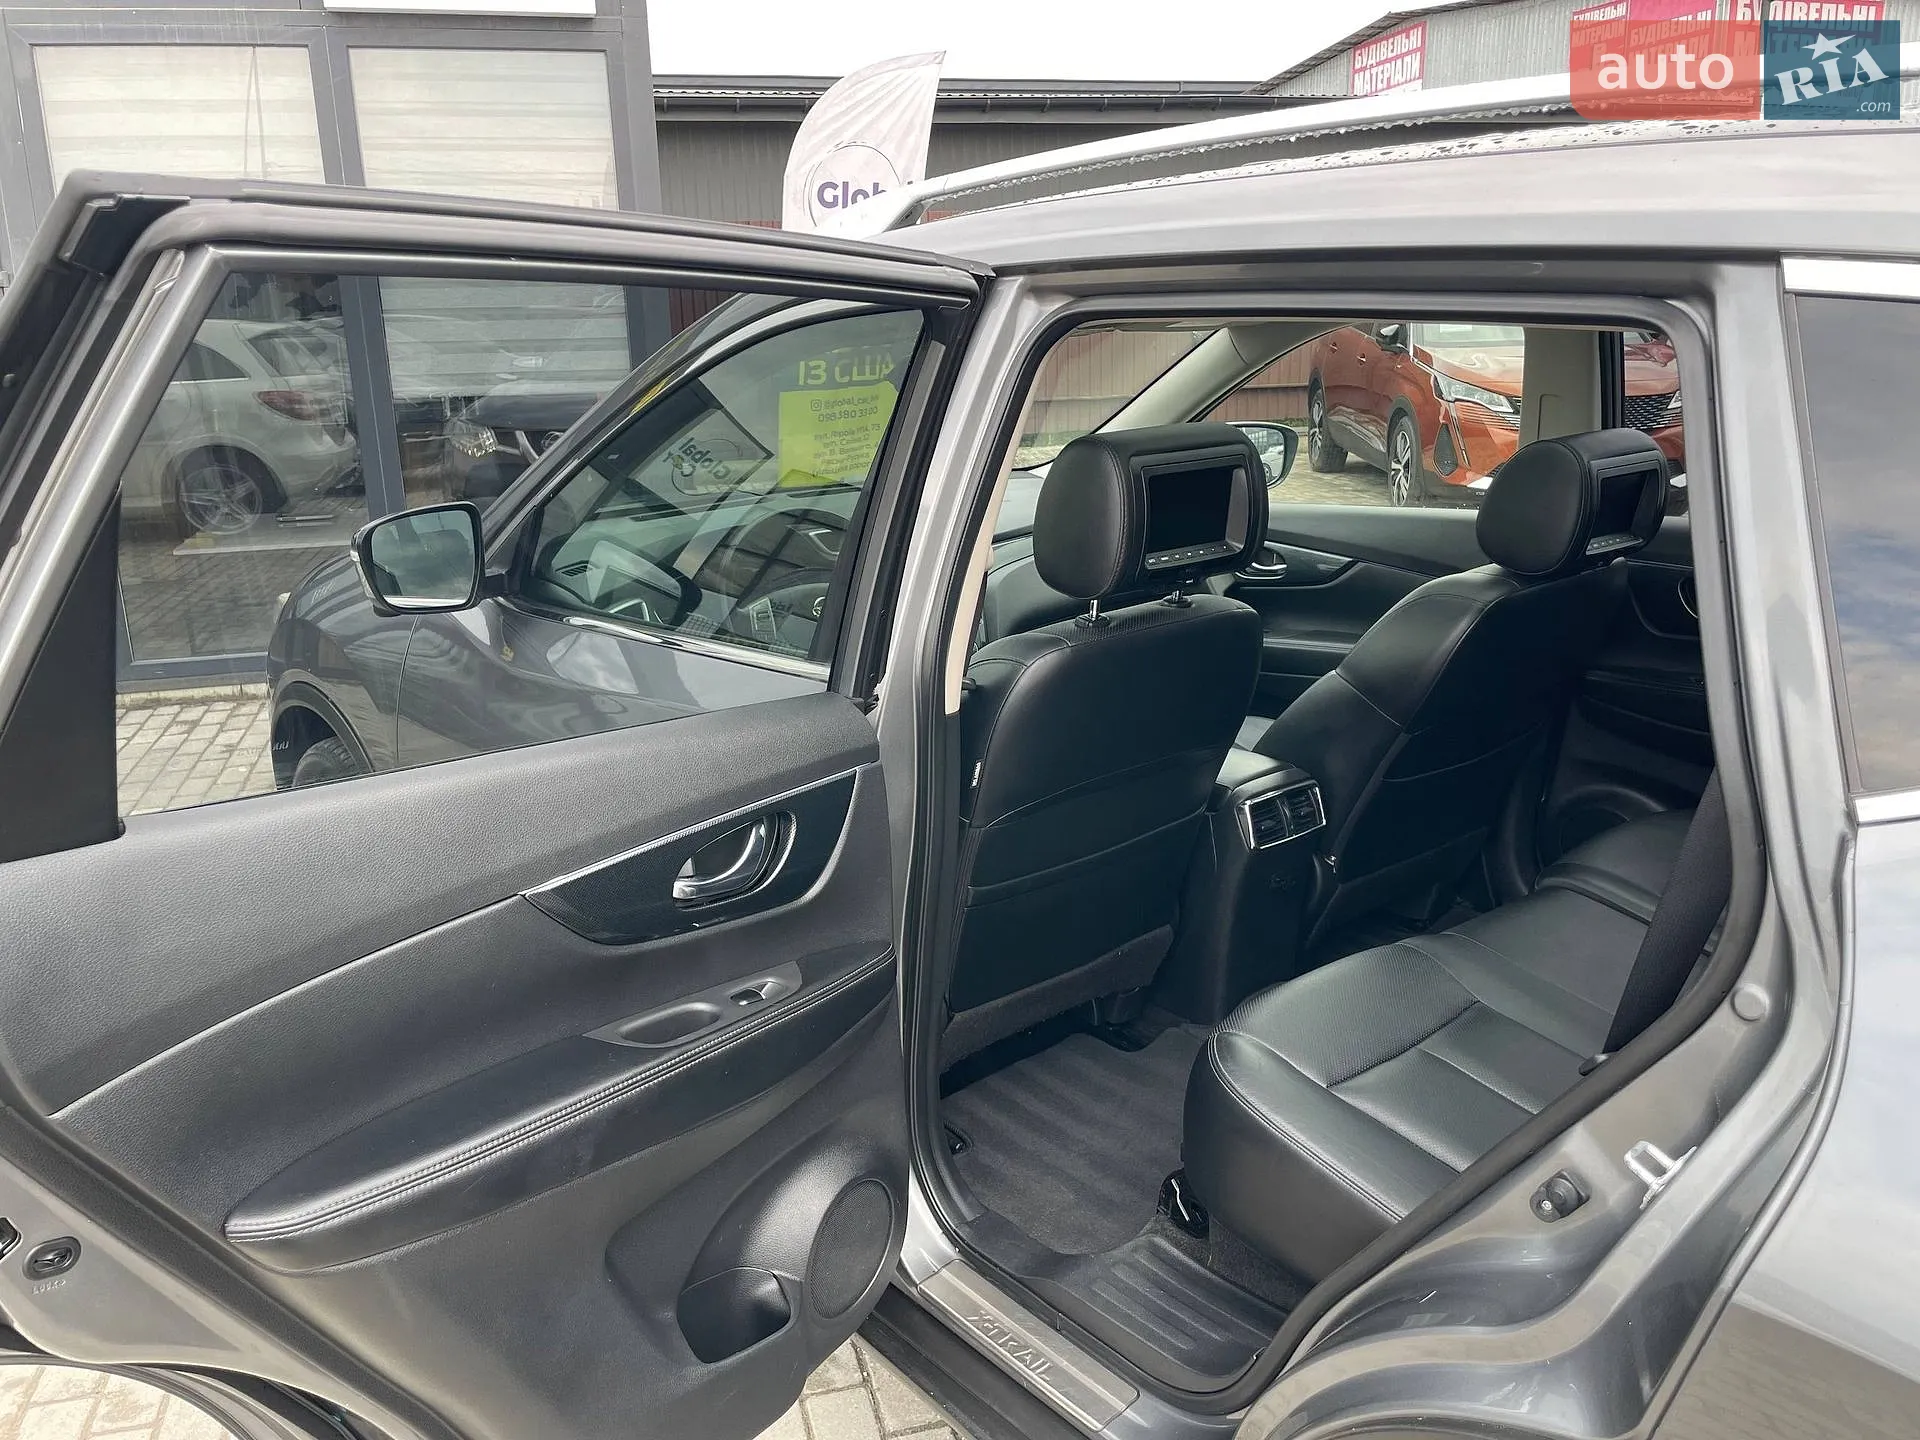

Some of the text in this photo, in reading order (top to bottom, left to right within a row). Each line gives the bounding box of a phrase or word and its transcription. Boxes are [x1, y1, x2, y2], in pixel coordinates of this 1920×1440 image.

[1354, 26, 1423, 68] БУДІВЕЛЬНІ
[1630, 9, 1713, 48] БУДІВЕЛЬНІ
[1353, 51, 1421, 96] МАТЕРІАЛИ
